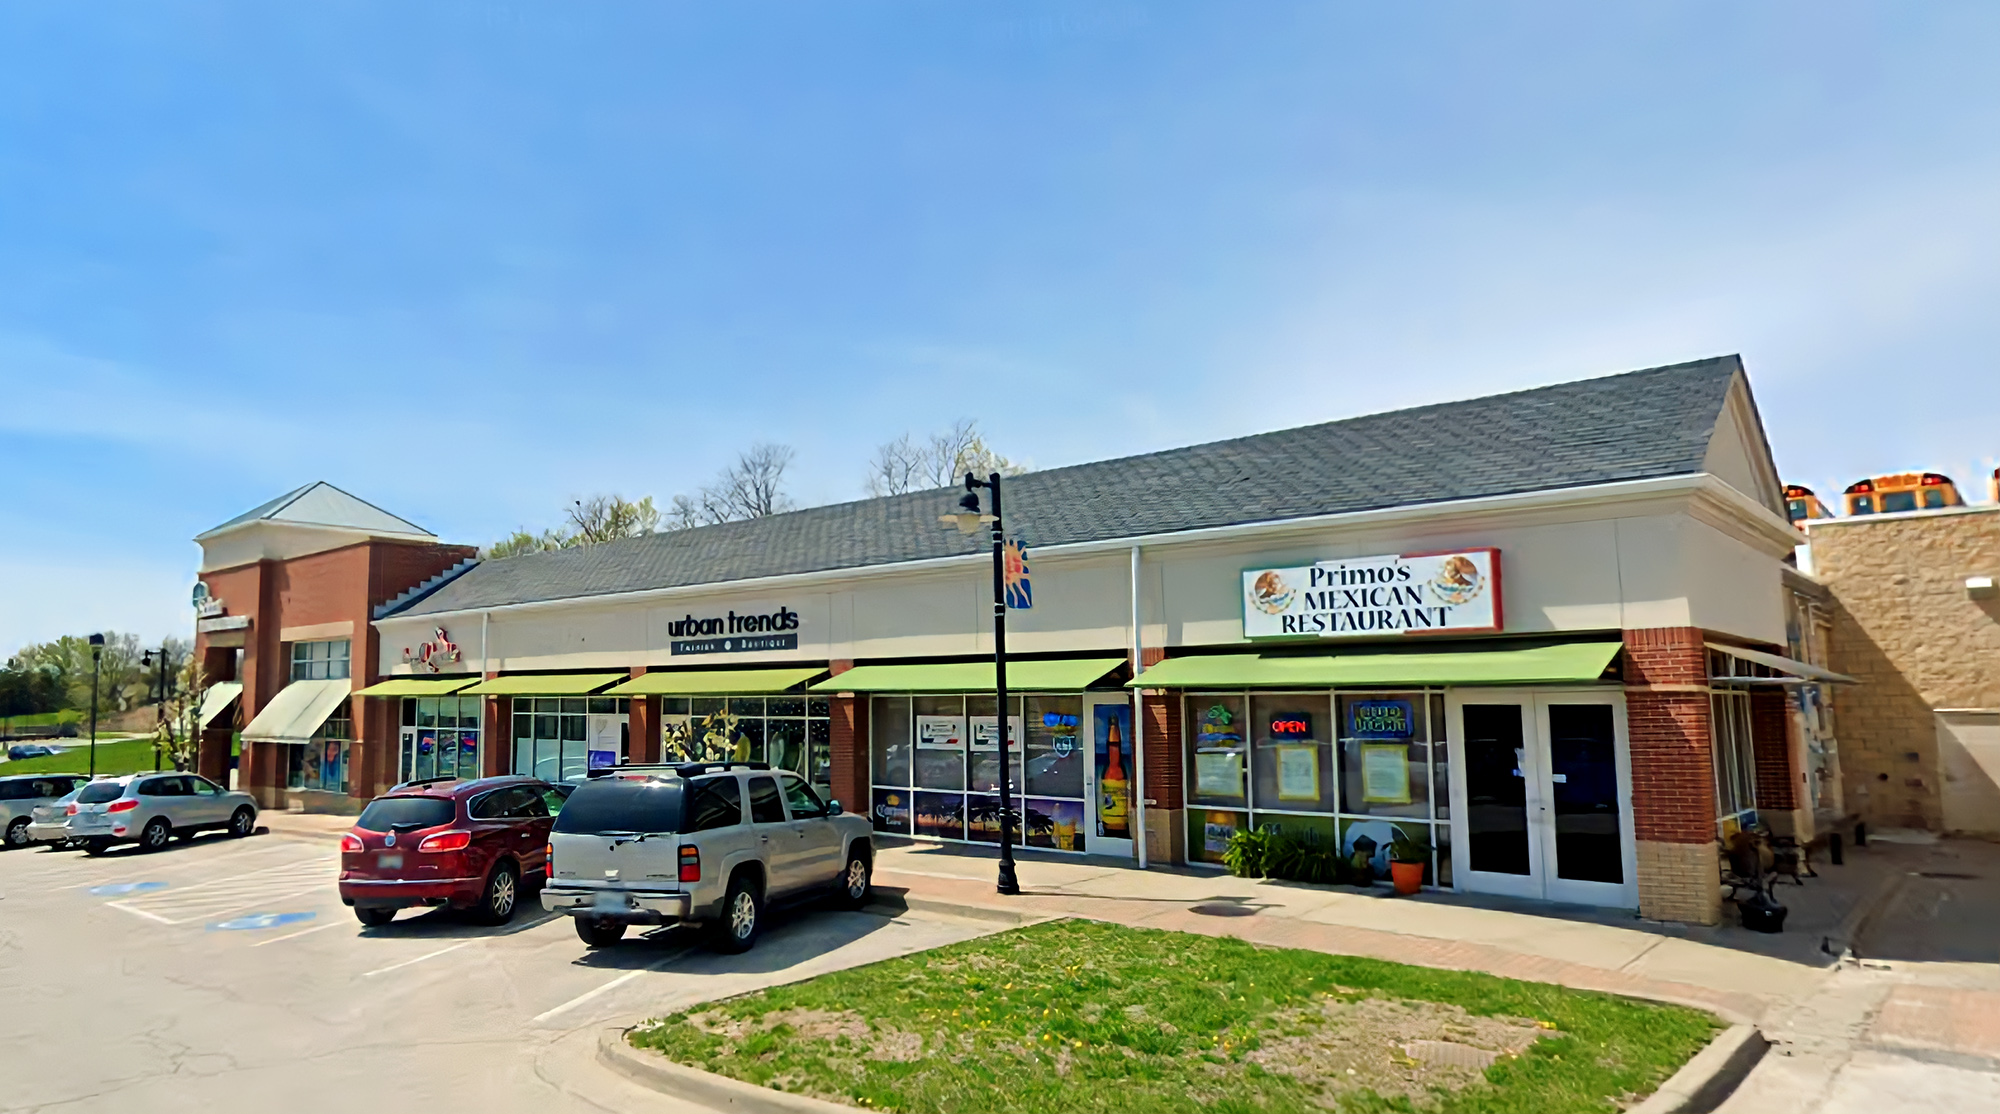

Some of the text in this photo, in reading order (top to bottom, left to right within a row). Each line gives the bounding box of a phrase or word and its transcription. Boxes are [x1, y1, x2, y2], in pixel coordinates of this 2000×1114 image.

[1310, 559, 1410, 586] Primo's
[1304, 585, 1422, 610] MEXICAN
[668, 606, 799, 636] urban trends
[1282, 607, 1452, 633] RESTAURANT
[1272, 720, 1306, 733] OPEN
